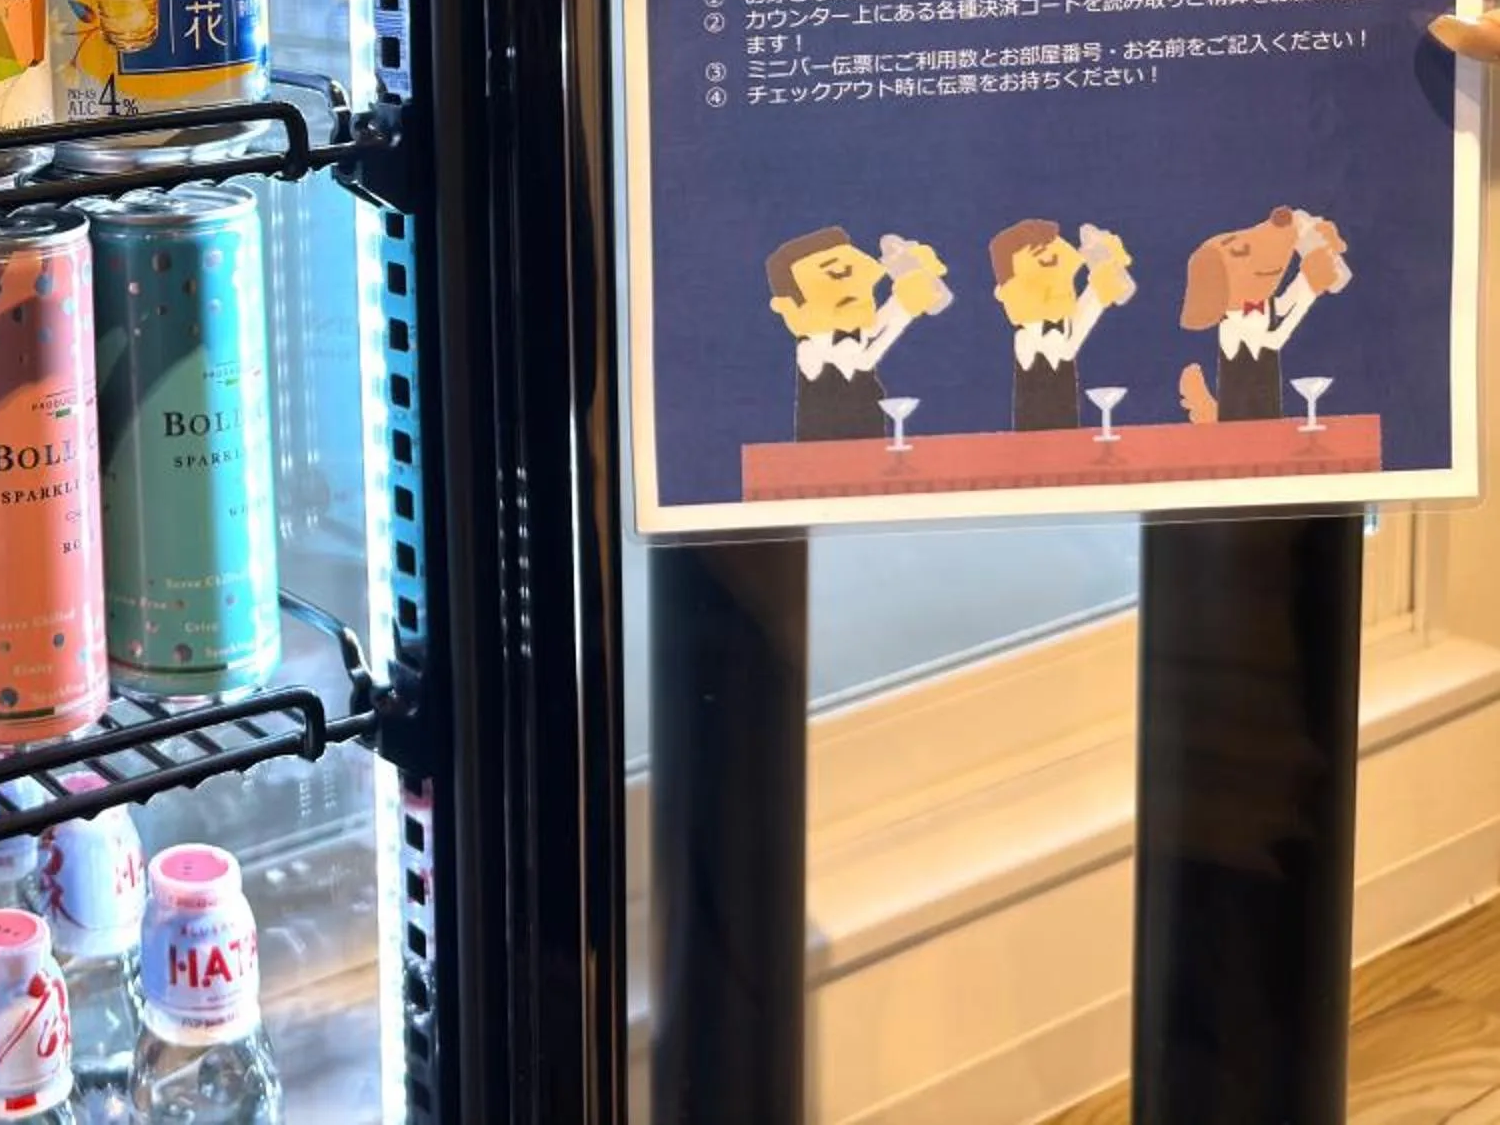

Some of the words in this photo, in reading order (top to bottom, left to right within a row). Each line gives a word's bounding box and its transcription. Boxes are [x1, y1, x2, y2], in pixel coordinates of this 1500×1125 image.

[746, 33, 802, 55] ます！
[748, 65, 1158, 105] チェックアウト時に伝票をお持ちください！
